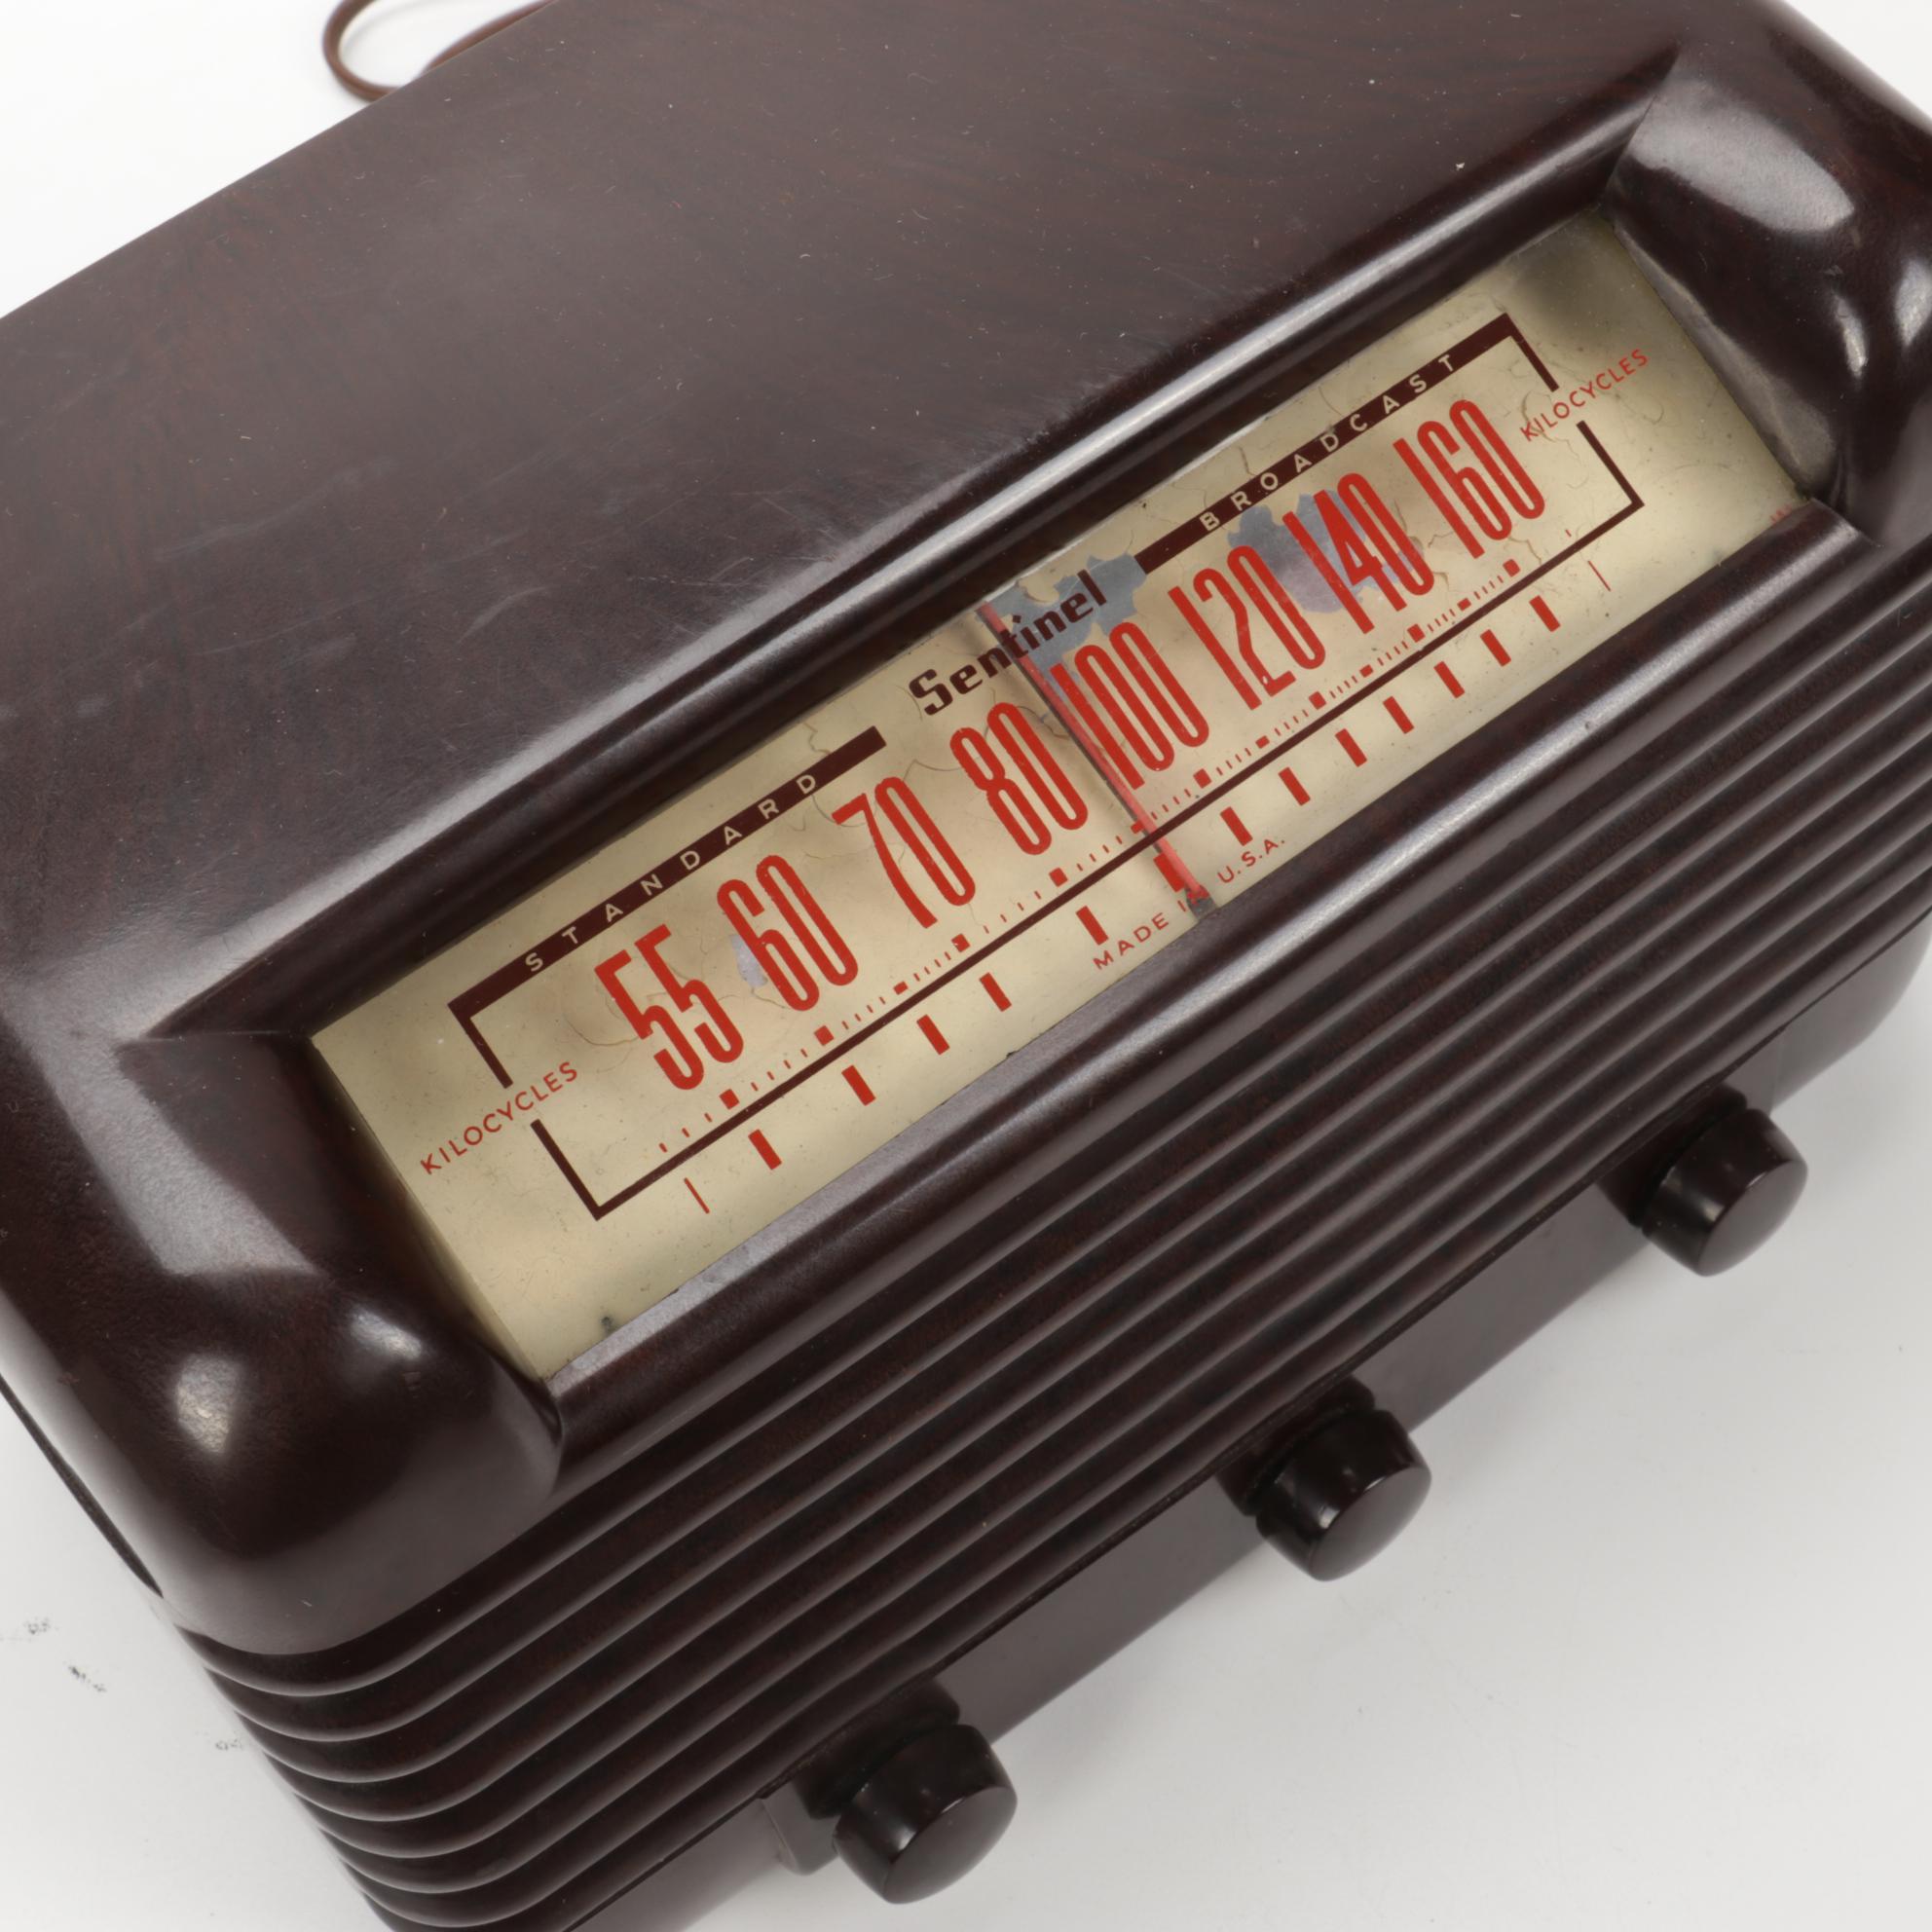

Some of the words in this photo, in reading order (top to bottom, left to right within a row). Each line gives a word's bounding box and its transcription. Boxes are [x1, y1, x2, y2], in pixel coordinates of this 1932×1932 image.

[1200, 354, 1455, 531] BROADCAST
[1519, 348, 1650, 442] KILOCYCLES
[909, 569, 1107, 716] Sentinel
[594, 924, 744, 1090] 55
[717, 855, 858, 1011] 60
[832, 776, 976, 929] 70
[949, 702, 1089, 855] 80
[1049, 621, 1209, 790] 100
[1168, 545, 1325, 710] 120
[1282, 472, 1434, 634] 140
[1393, 399, 1545, 558] 160
[525, 774, 816, 972] STANDARD
[1093, 912, 1170, 970] MADE
[1217, 838, 1285, 883] U.S.A.
[420, 1061, 578, 1175] KILOCYCLES
